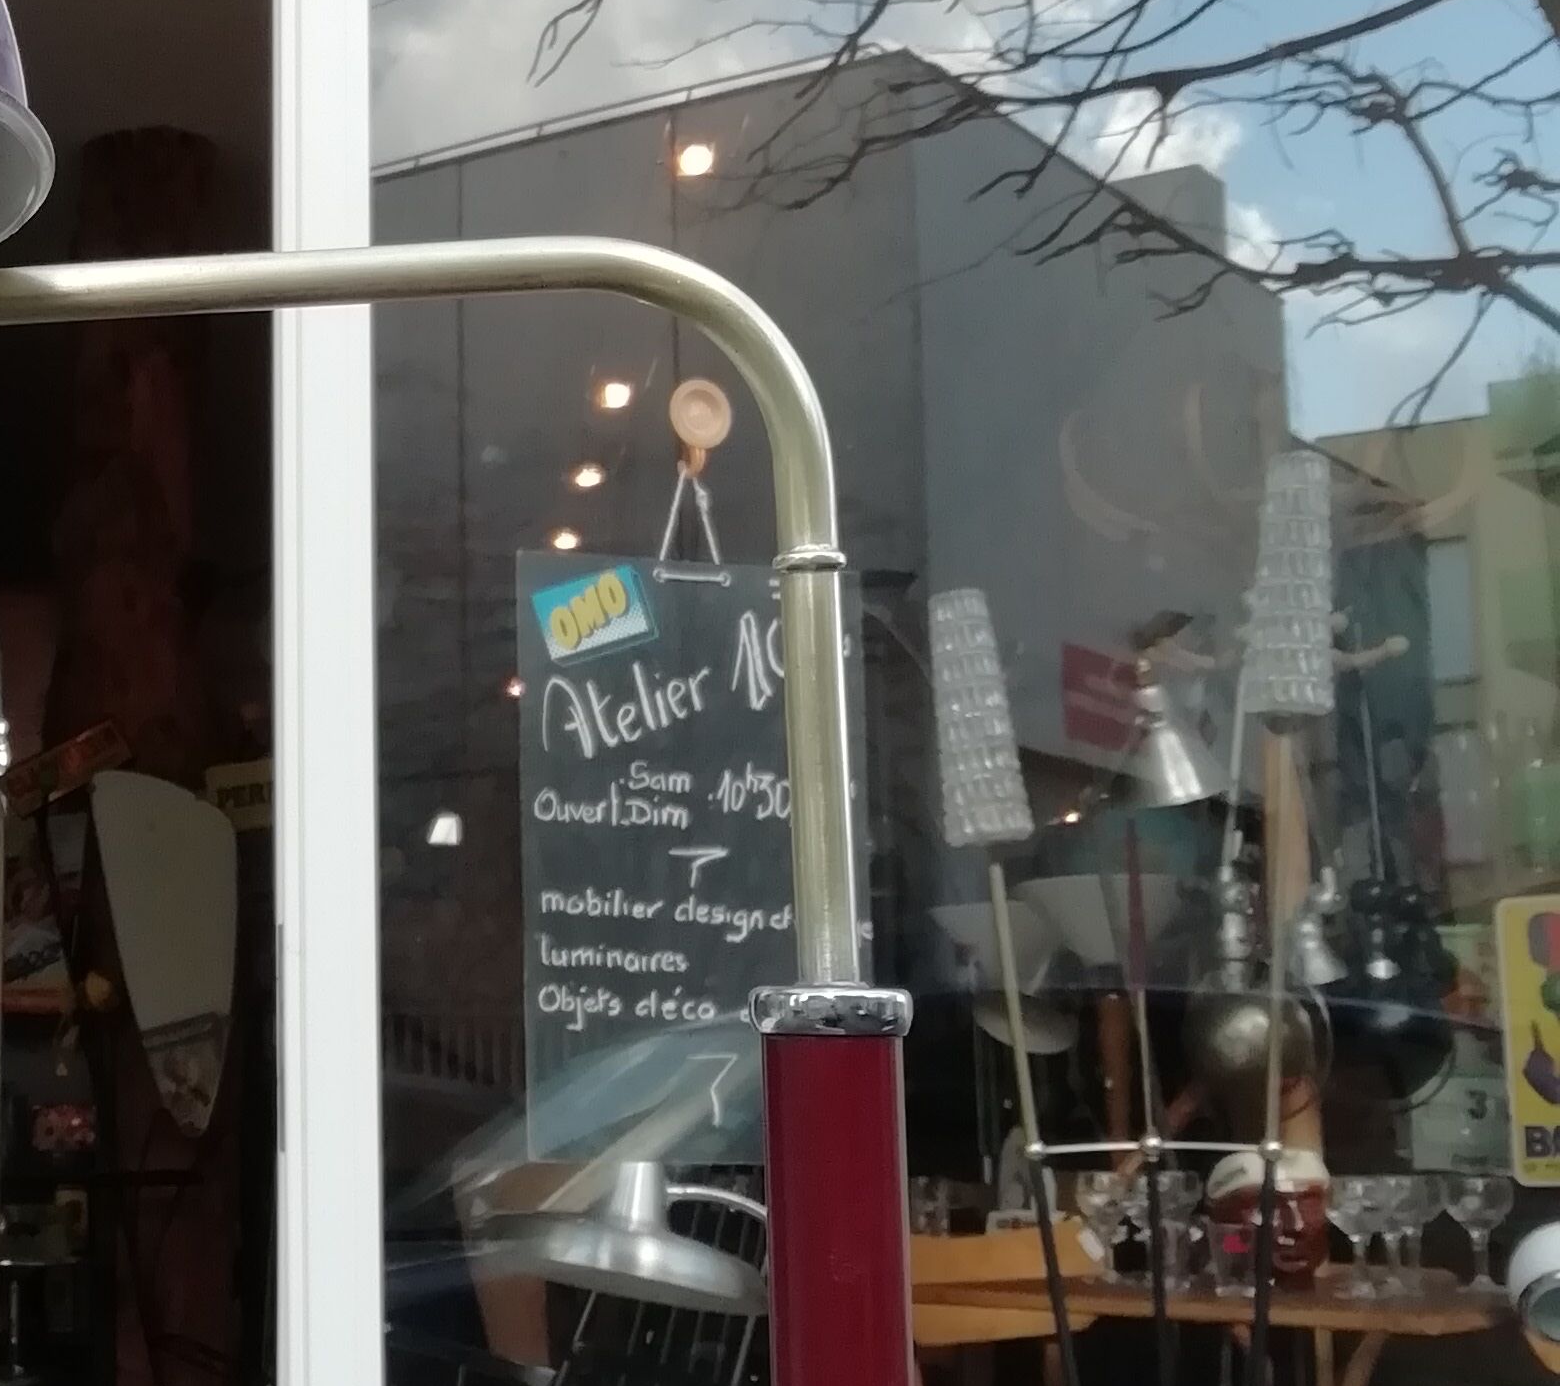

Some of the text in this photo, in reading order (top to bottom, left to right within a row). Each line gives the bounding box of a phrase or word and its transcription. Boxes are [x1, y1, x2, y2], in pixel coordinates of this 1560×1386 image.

[551, 571, 628, 651] OMO
[542, 661, 710, 759] Atelier
[541, 887, 664, 919] mobilier
